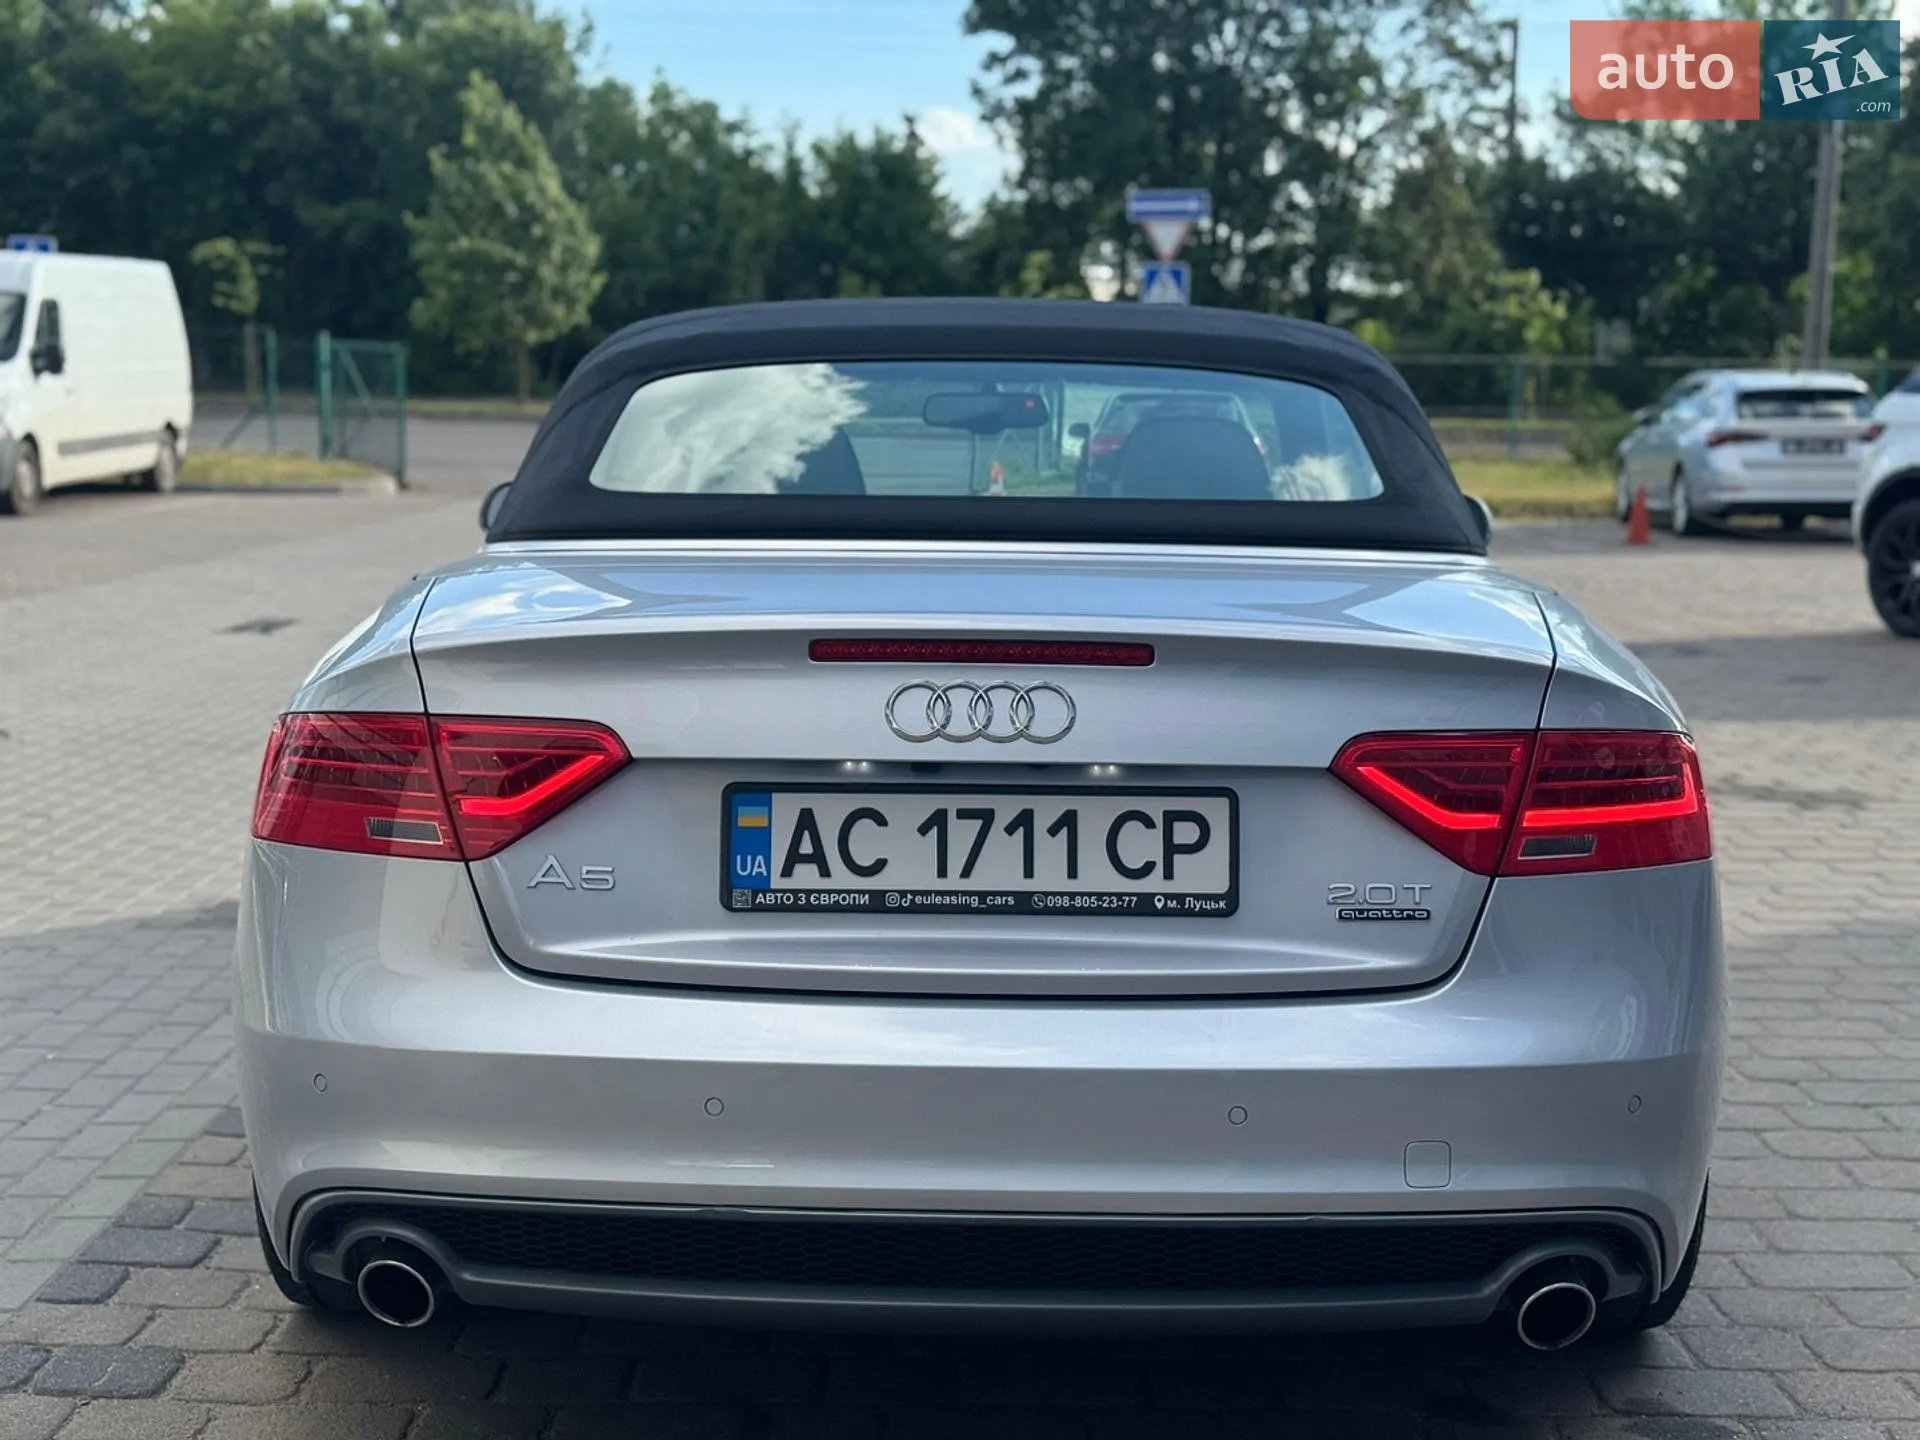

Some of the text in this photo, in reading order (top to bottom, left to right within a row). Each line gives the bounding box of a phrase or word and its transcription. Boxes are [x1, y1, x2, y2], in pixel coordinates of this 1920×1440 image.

[779, 807, 1212, 881] AC 1711 CP
[527, 853, 616, 891] A5
[736, 854, 768, 877] UA
[755, 893, 794, 904] АВТО
[810, 893, 869, 905] ЄВРОПИ
[914, 893, 1015, 908] euleasing_cars
[1047, 896, 1137, 908] 098-805-23-77
[1185, 897, 1226, 911] Луцьк
[1341, 909, 1428, 920] quattro
